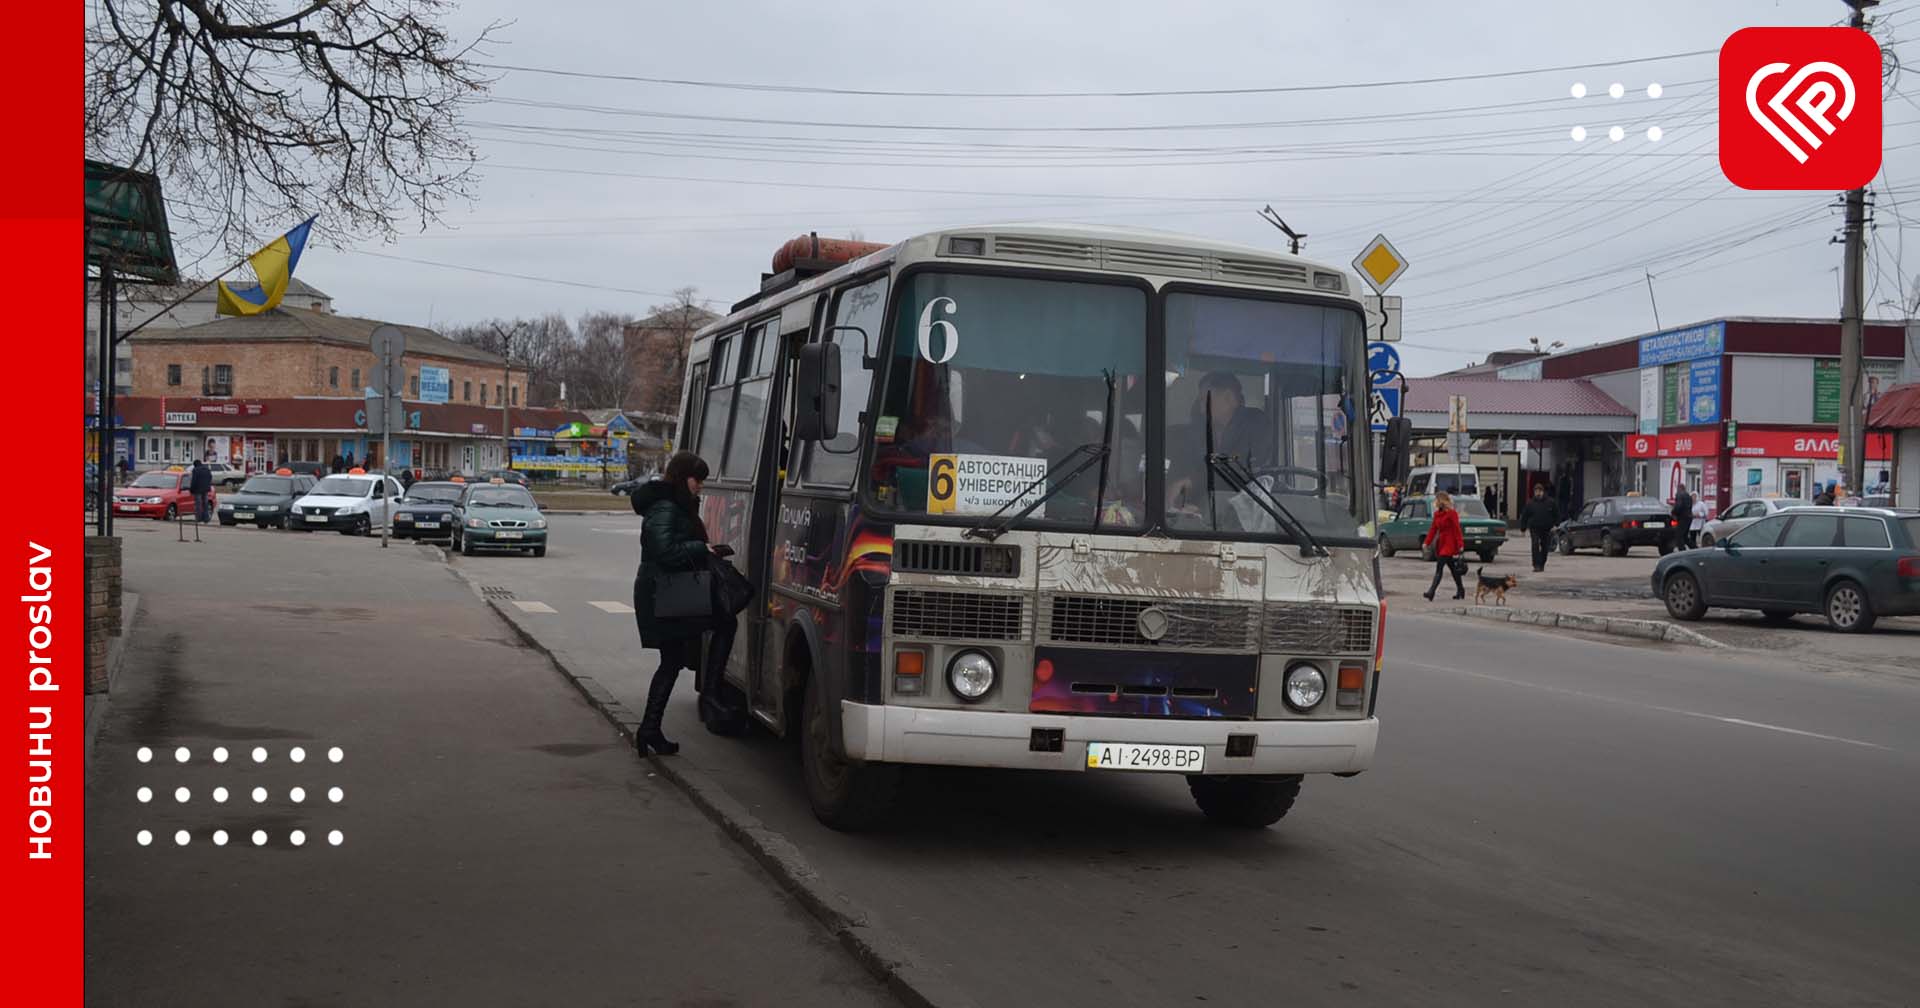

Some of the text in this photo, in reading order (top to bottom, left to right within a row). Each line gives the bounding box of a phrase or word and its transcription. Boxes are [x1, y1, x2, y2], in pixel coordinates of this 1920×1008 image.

[918, 296, 959, 364] 6
[167, 413, 195, 422] АПТЕКА
[930, 458, 955, 501] 6
[958, 460, 1045, 480] АВТОСТАНЦІЯ
[959, 478, 1044, 495] УНІВЕРСИТЕТ
[1131, 748, 1170, 766] 2498
